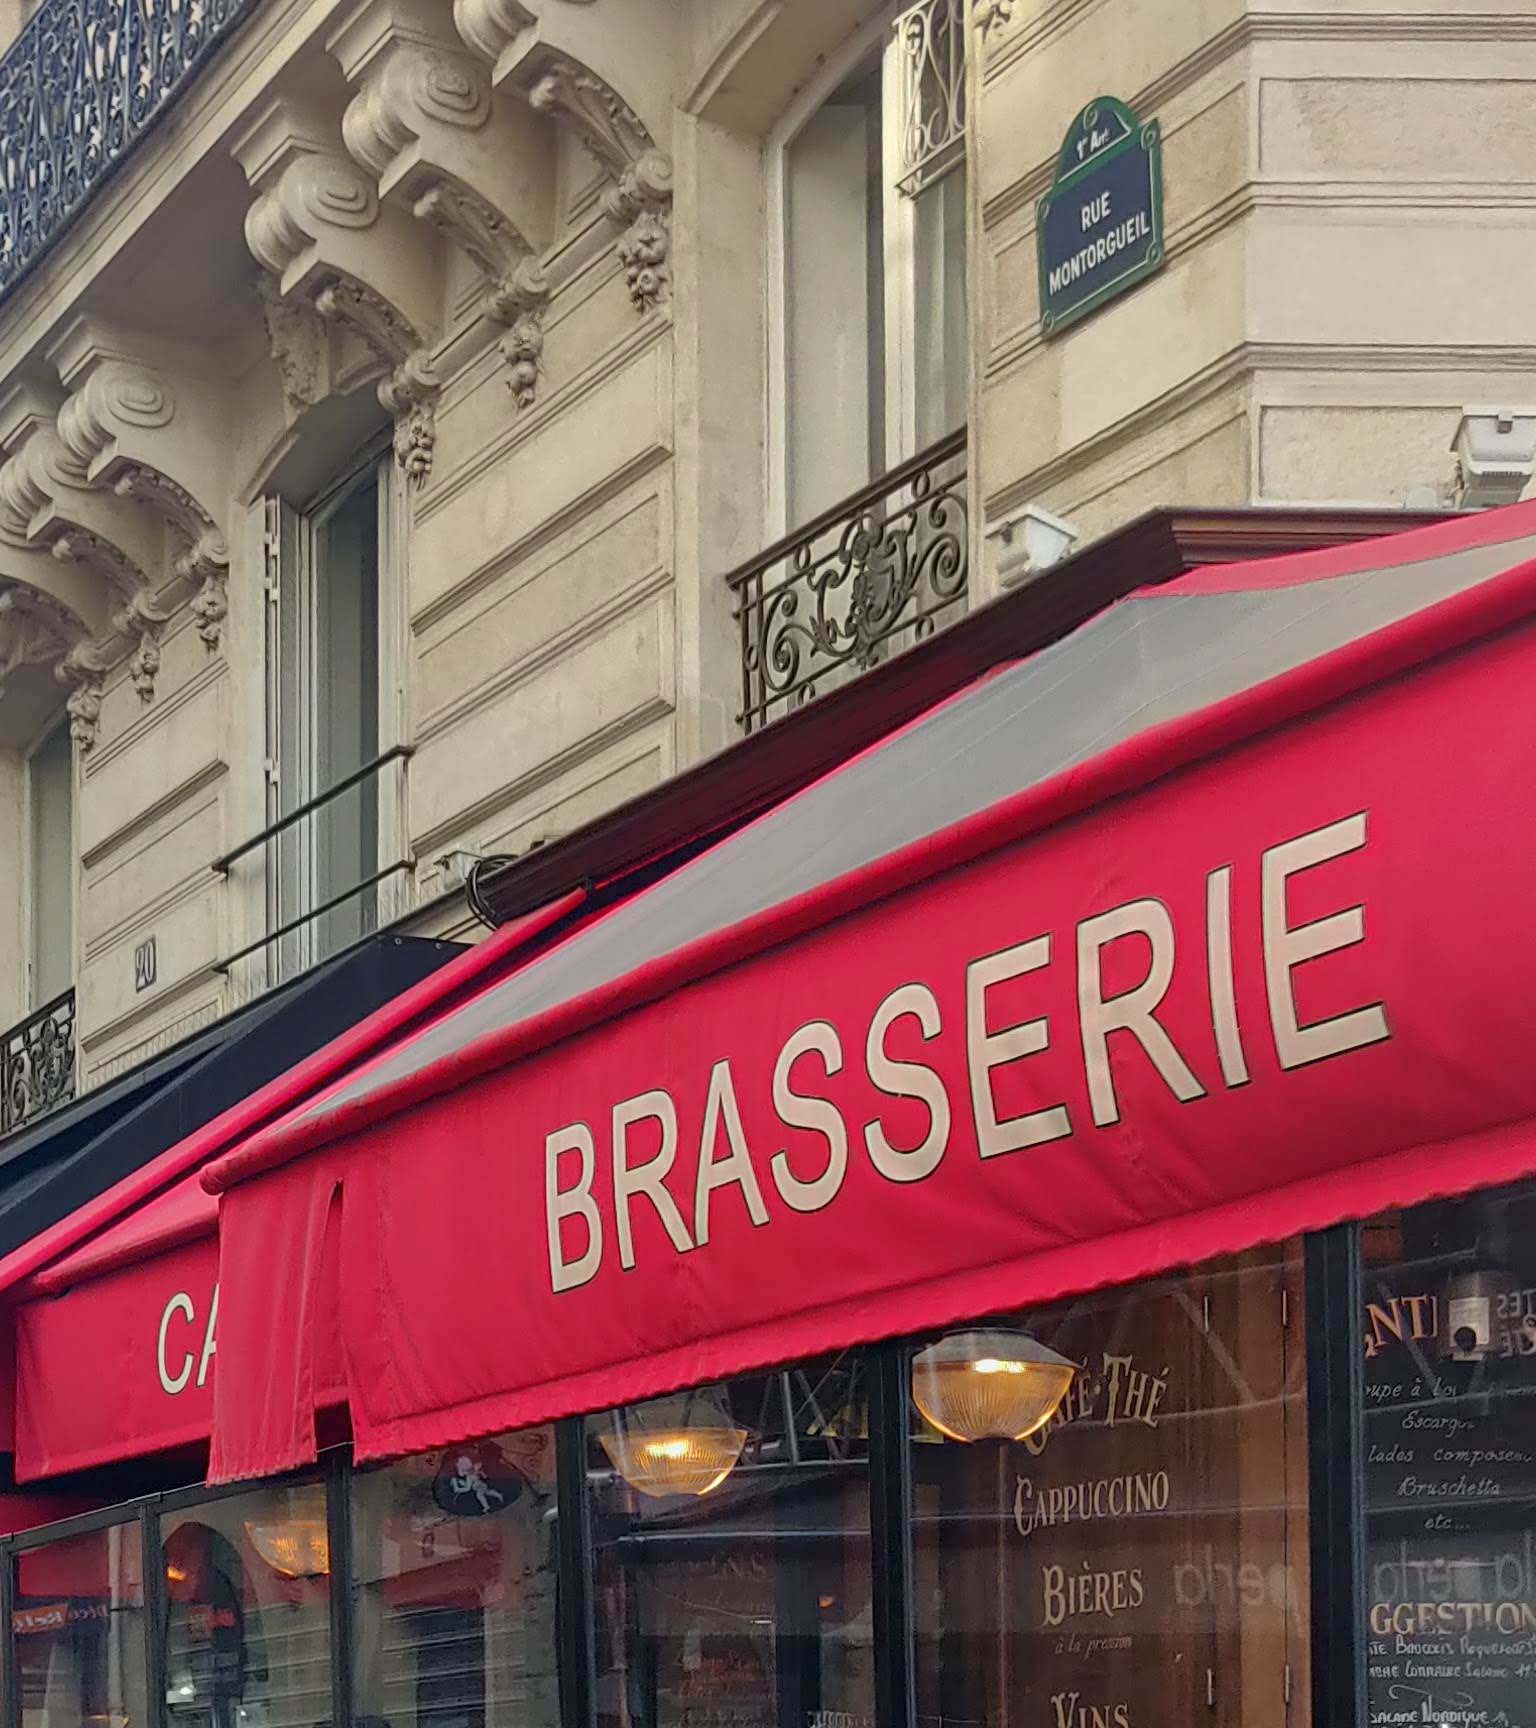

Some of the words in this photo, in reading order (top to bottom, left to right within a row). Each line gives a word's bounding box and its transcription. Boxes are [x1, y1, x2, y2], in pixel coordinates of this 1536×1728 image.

[1080, 190, 1111, 232] RUE
[1049, 210, 1150, 296] MONTORGUEIL
[136, 940, 155, 988] 20
[544, 809, 1391, 1294] BRASSERIE
[1014, 1471, 1169, 1536] CAPPUCCINO
[1398, 1475, 1501, 1497] Bruschetta
[1042, 1561, 1144, 1626] BIÈRES
